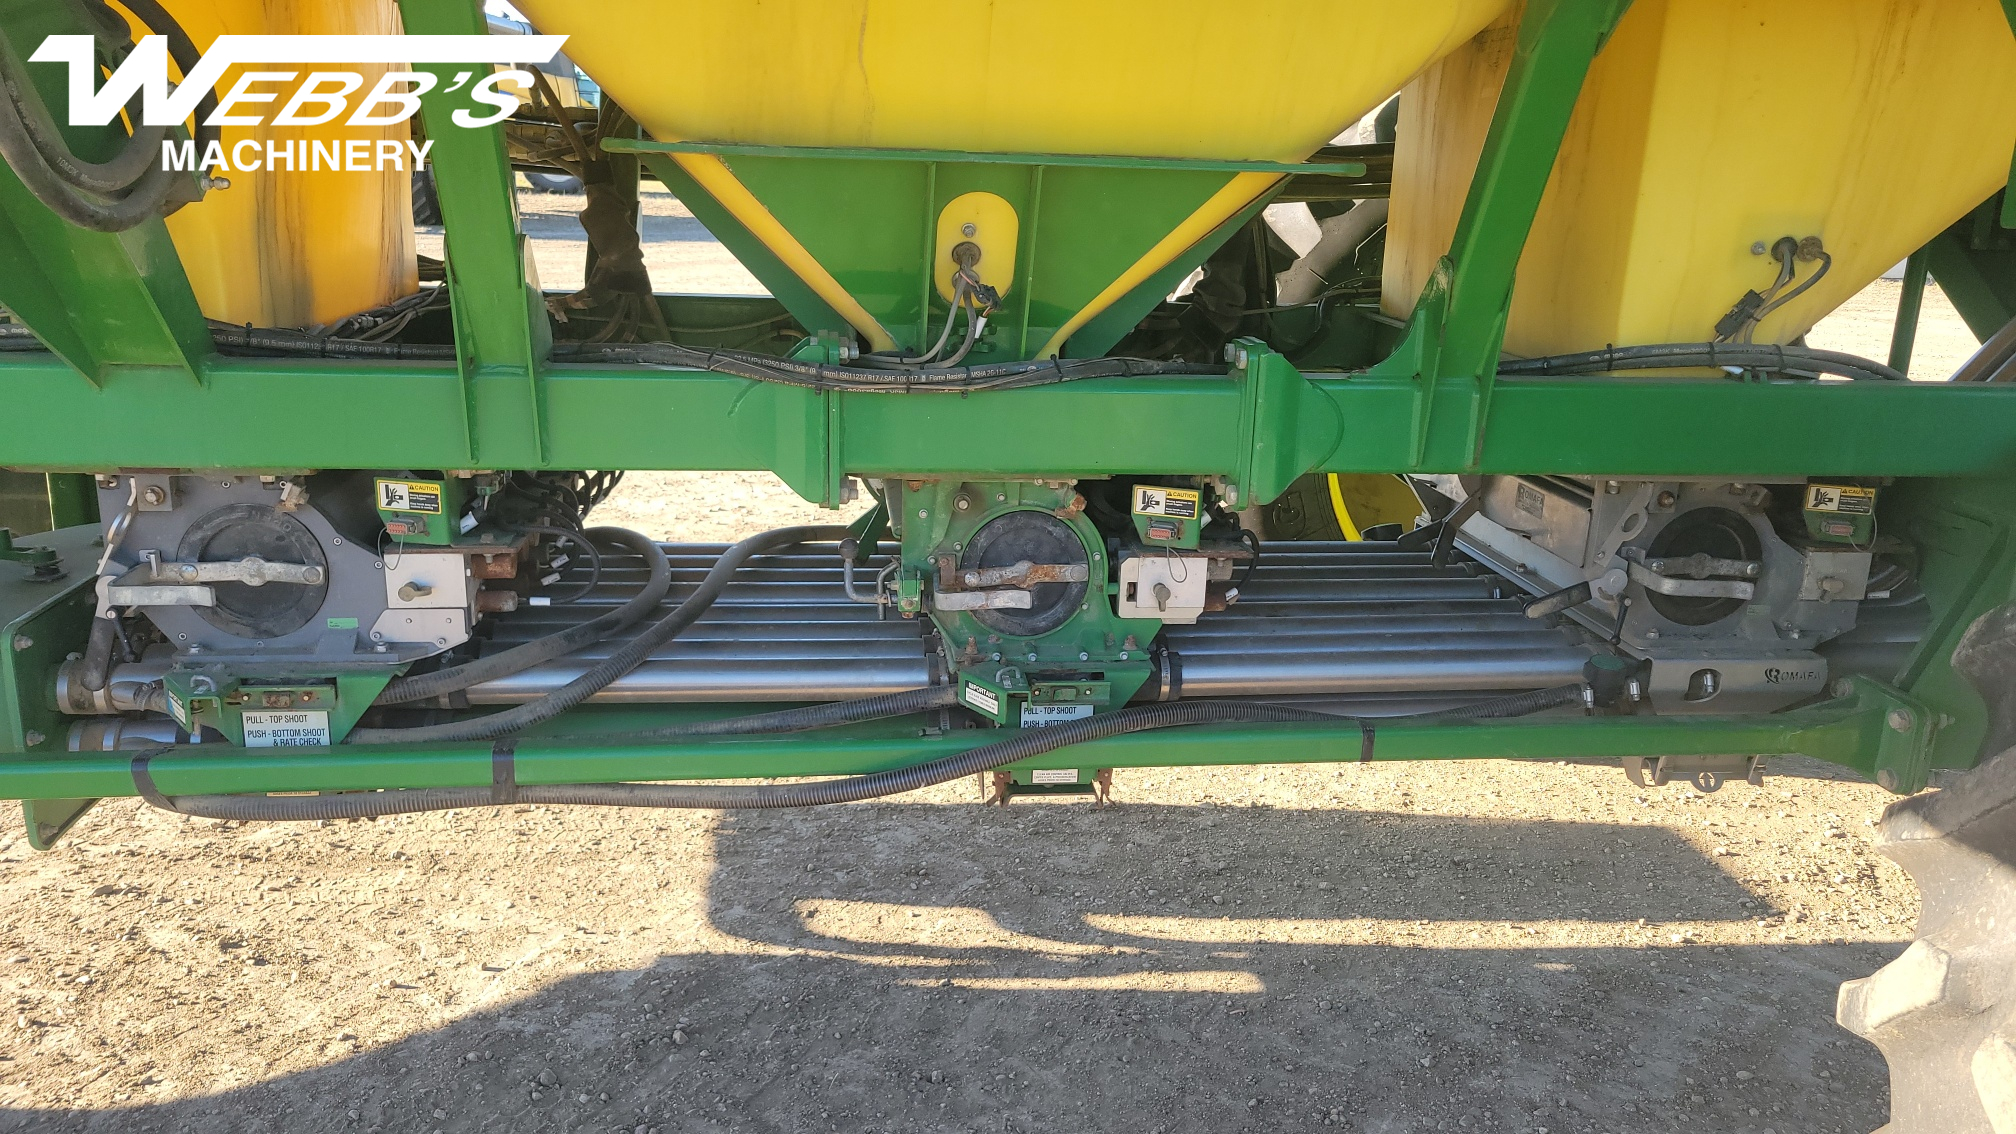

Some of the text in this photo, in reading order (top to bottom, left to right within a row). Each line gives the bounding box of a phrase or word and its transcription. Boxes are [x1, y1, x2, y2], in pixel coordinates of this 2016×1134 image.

[762, 359, 780, 369] (3250
[780, 361, 794, 371] PSI)
[840, 371, 867, 380] ISO11237
[867, 373, 880, 381] R17
[971, 370, 987, 378] MSHA
[414, 484, 439, 492] CAUTION
[1172, 491, 1197, 499] CAUTION
[968, 681, 996, 700] IMPORTANT
[1023, 707, 1039, 715] PULL
[1044, 706, 1056, 715] TOP
[1056, 706, 1077, 715] SHOOT
[246, 715, 264, 725] PULL
[269, 715, 283, 724] TOP
[284, 714, 308, 724] SHOOT
[1023, 720, 1040, 728] PUSH
[247, 729, 267, 739] PUSH
[272, 728, 301, 738] BOTTOM
[302, 728, 326, 737] SHOOT
[273, 737, 322, 747] & RATE CHECK
